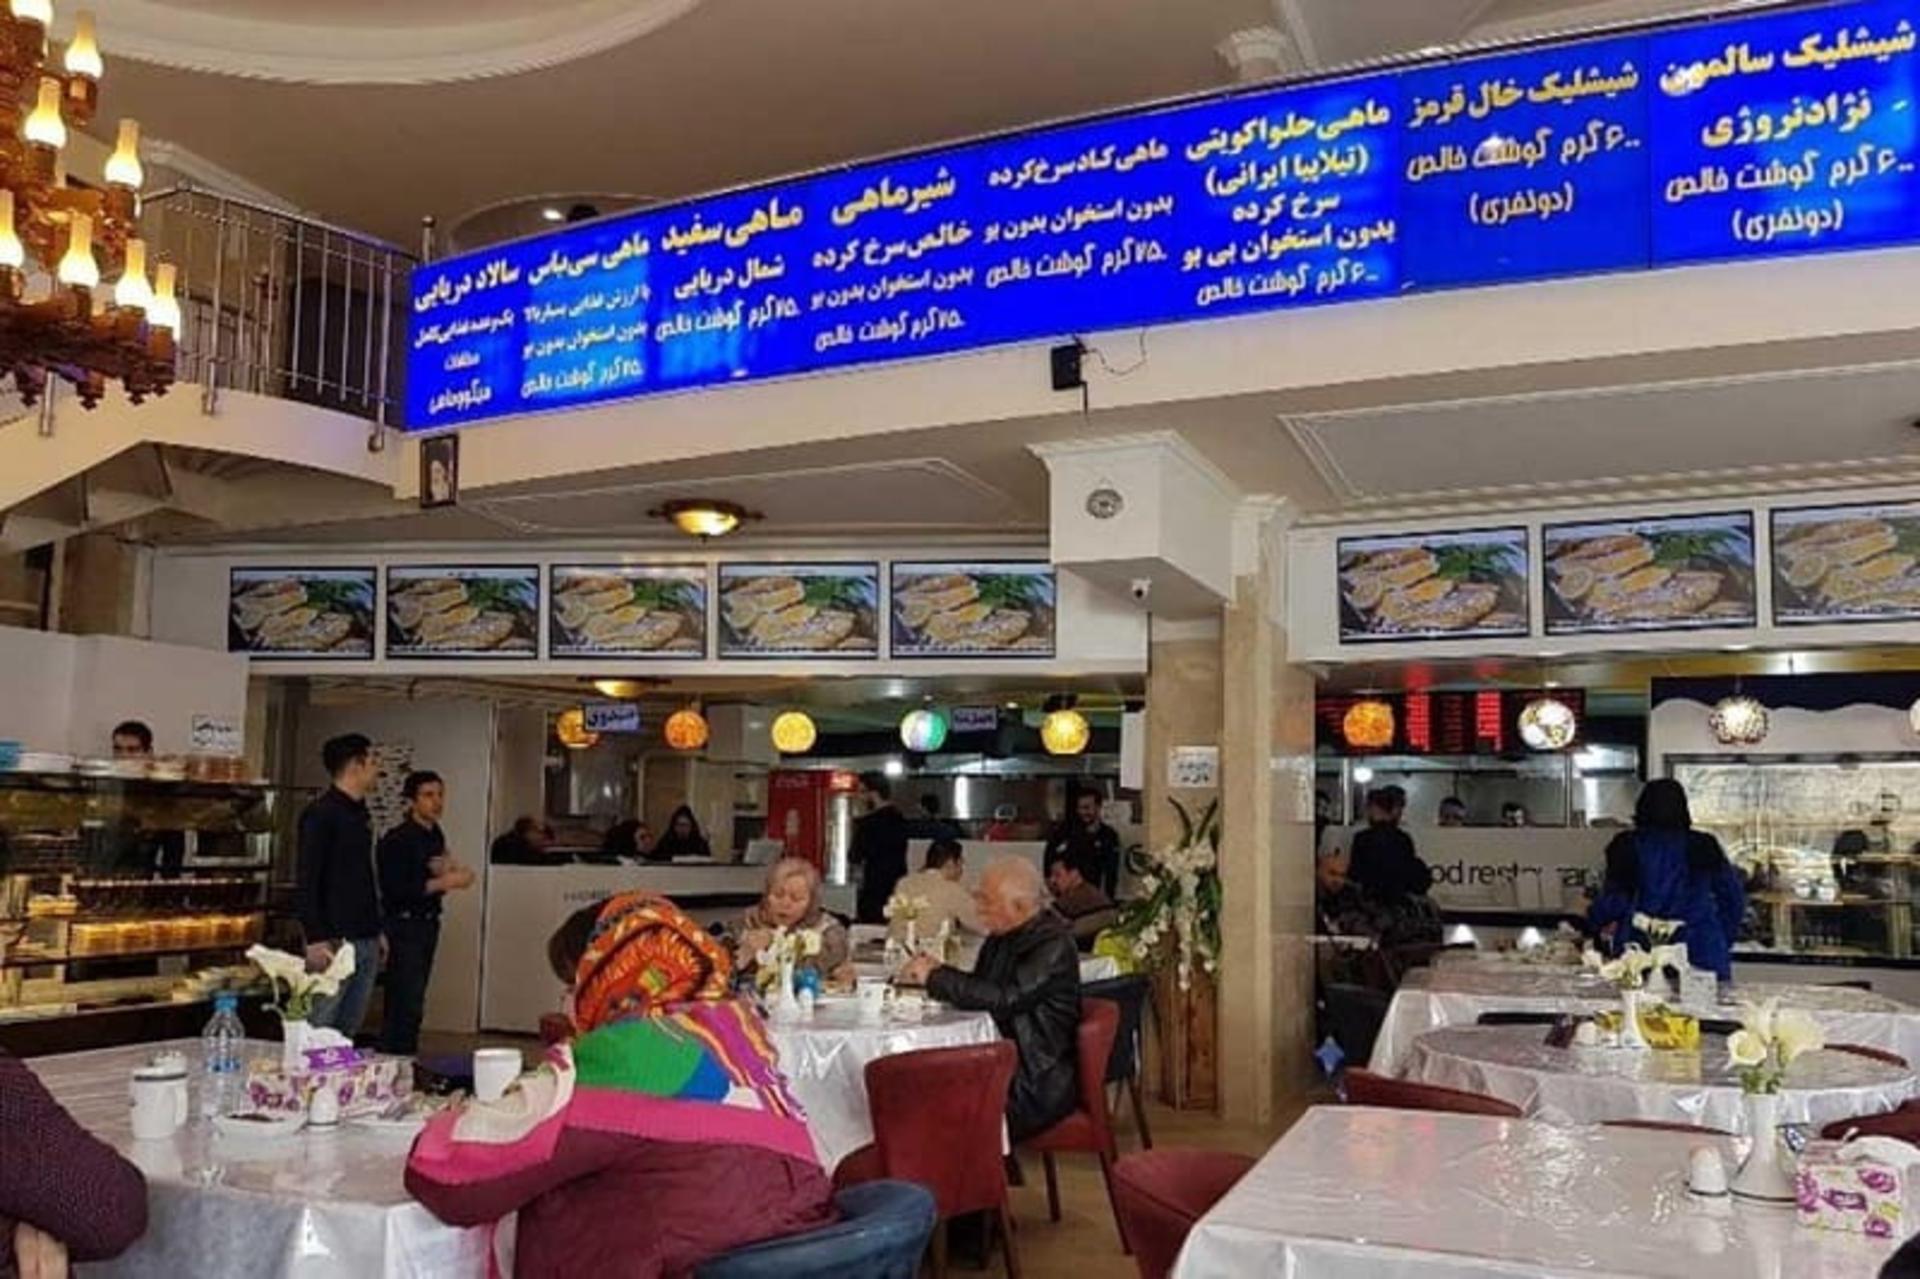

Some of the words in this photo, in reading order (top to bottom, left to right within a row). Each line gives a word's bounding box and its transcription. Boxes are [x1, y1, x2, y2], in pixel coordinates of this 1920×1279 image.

[1782, 20, 1916, 70] شیشلیک
[1527, 62, 1639, 105] شیشلیک
[1659, 43, 1775, 97] سالمون
[1409, 82, 1466, 128] قرمز
[1468, 79, 1525, 119] خال
[1259, 112, 1319, 150] حلوا
[1316, 99, 1391, 141] ماهی
[1114, 138, 1169, 172] ماهی
[1185, 118, 1262, 161] کویتی
[1472, 127, 1552, 168] گوشت
[1560, 119, 1604, 164] گرم
[988, 158, 1036, 189] کرده
[1205, 156, 1288, 196] ایرانی)
[1406, 146, 1467, 181] خالص
[1735, 150, 1820, 191] گوشت
[1829, 143, 1874, 188] گرم
[831, 164, 956, 226] شیرماهی
[1665, 166, 1729, 203] خالص
[724, 197, 803, 248] ماهی
[1050, 199, 1124, 234] استخوان
[1126, 196, 1173, 222] بدون
[1232, 193, 1286, 226] کرده
[1291, 191, 1340, 220] سرخ
[661, 213, 724, 256] سفید
[905, 220, 973, 259] خالص
[984, 223, 1000, 244] بو
[1003, 215, 1048, 240] بدون
[1241, 223, 1332, 263] استخوان
[1336, 220, 1395, 250] بدون
[601, 232, 650, 270] ماهی
[812, 239, 860, 272] کرده
[863, 238, 908, 266] سرخ
[1035, 242, 1096, 278] گوشت
[1101, 236, 1135, 275] گرم
[1182, 247, 1203, 272] بو
[1206, 242, 1237, 268] بی
[475, 259, 520, 290] سالاد
[674, 267, 735, 300] دریایی
[737, 255, 785, 289] شمال
[867, 269, 931, 301] استخوان
[932, 267, 974, 291] بدون
[986, 257, 1032, 289] خالص
[1247, 263, 1310, 296] گوشت
[1316, 257, 1350, 294] گرم
[414, 274, 473, 312] دریایی
[810, 292, 825, 310] بو
[826, 285, 865, 308] بدون
[1196, 276, 1245, 306] خالص
[615, 322, 648, 342] بدون
[655, 313, 693, 342] خالص
[694, 299, 744, 331] گوشت
[858, 311, 909, 342] گوشت
[814, 324, 854, 352] خالص
[554, 361, 595, 389] گوشت
